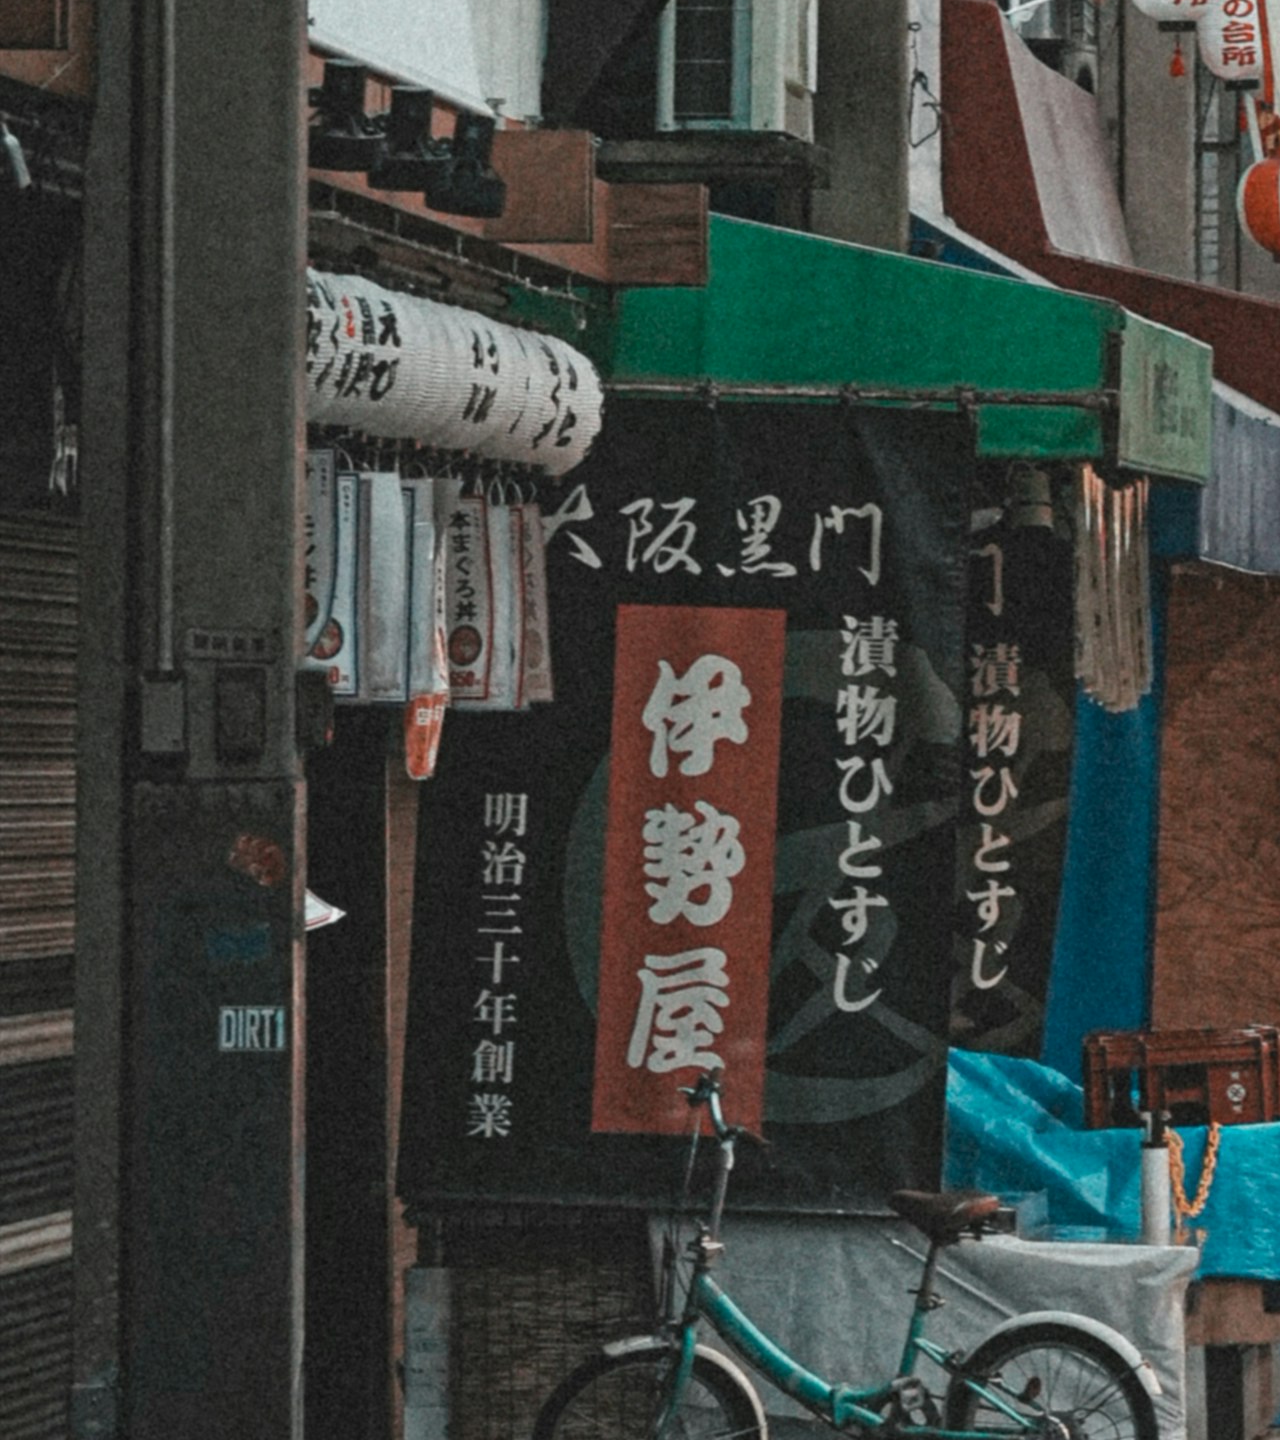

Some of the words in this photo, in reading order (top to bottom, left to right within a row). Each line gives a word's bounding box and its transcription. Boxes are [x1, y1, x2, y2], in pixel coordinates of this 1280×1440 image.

[449, 510, 479, 621] 本まぐろ丼
[544, 483, 884, 586] 大阪黒門
[467, 793, 529, 1138] 明治三十年創業
[626, 653, 752, 1073] 伊勢屋
[828, 614, 900, 1013] 漬物ひとすじ
[965, 642, 1022, 991] 漬物ひとすじ
[220, 1007, 285, 1050] DIRT1
